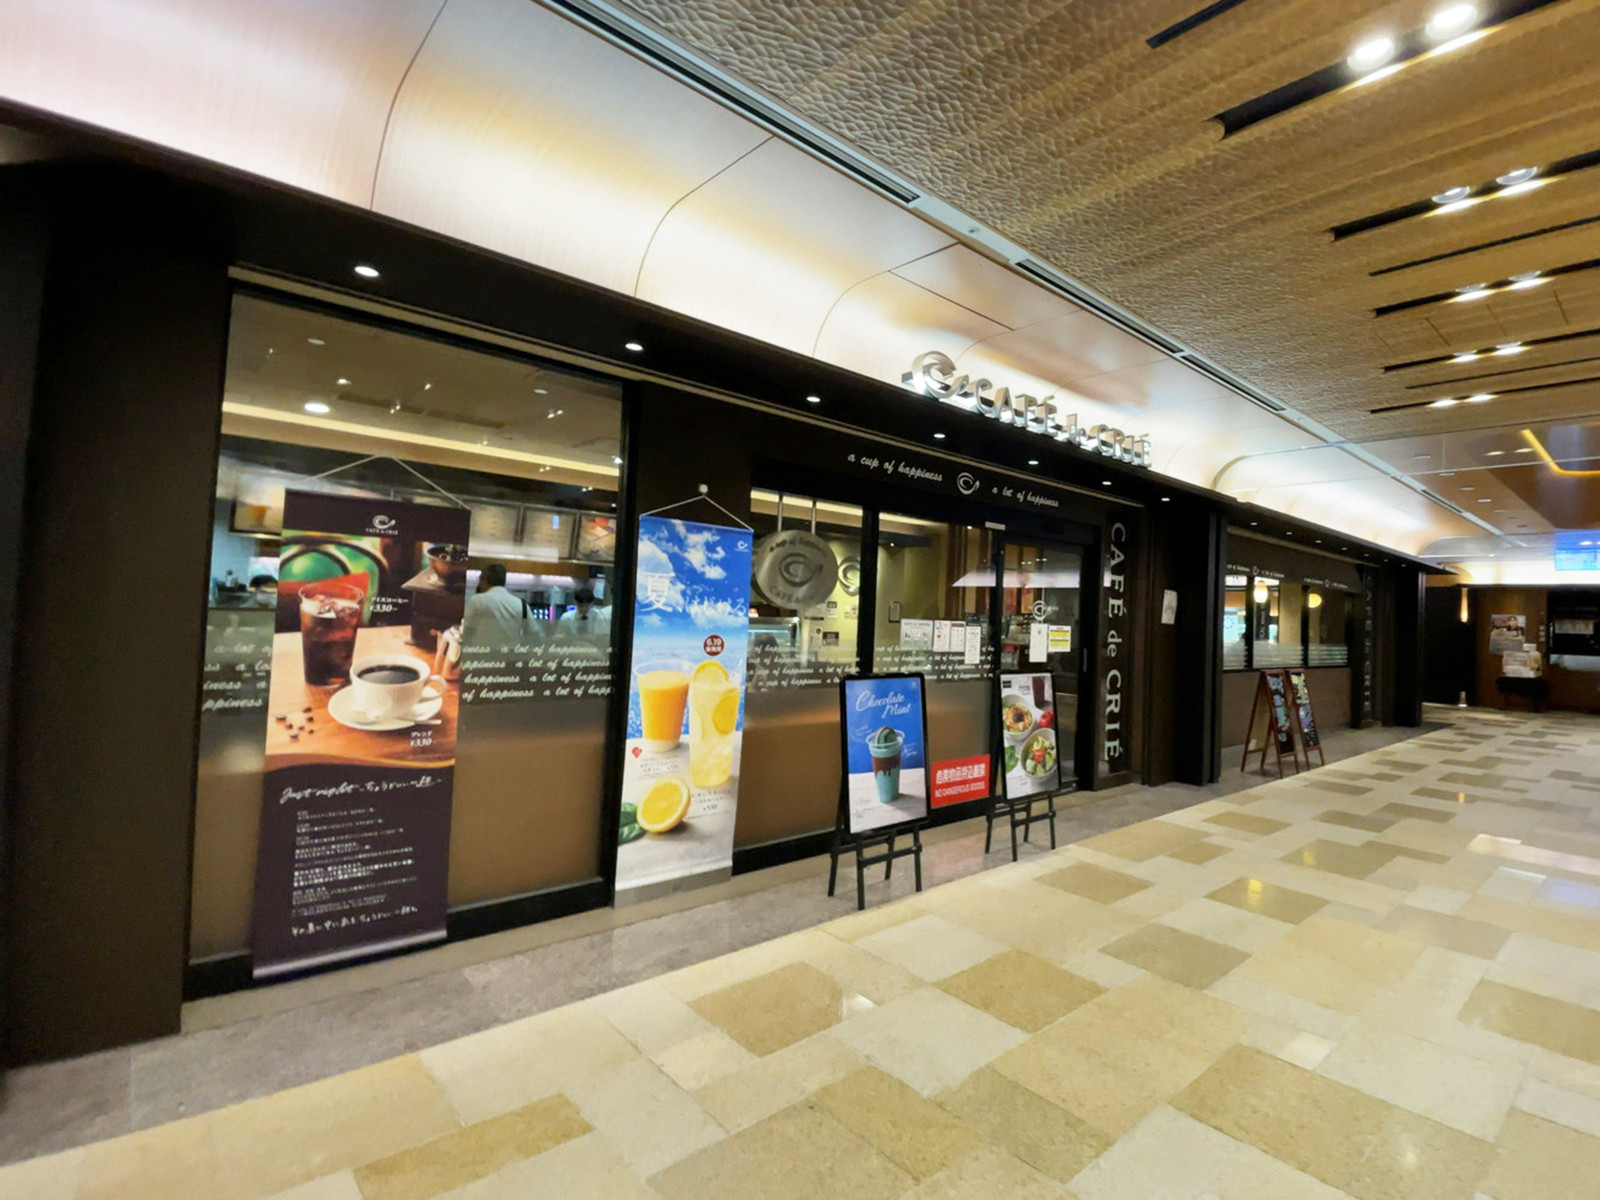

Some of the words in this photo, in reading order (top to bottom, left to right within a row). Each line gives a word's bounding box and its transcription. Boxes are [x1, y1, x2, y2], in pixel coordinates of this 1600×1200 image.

[967, 378, 1058, 437] CAFÉ
[1089, 424, 1151, 470] CRIÉ
[848, 453, 856, 462] a
[860, 456, 879, 470] cup
[883, 460, 894, 474] of
[897, 462, 943, 482] happiness
[992, 486, 998, 494] a
[1002, 486, 1013, 498] lot
[1017, 491, 1025, 503] of
[1027, 491, 1059, 508] happiness
[1108, 523, 1126, 618] CAFÉ
[514, 644, 530, 654] lot
[533, 644, 545, 656] of
[548, 644, 597, 656] happiness
[1107, 630, 1122, 657] de
[528, 659, 544, 668] lot
[547, 659, 559, 671] of
[562, 658, 610, 669] happiness
[464, 673, 520, 685] happiness
[542, 672, 557, 682] lot
[560, 672, 572, 684] of
[462, 689, 476, 702] of
[479, 687, 534, 700] happiness
[555, 686, 570, 696] lot
[573, 686, 584, 698] of
[856, 690, 905, 711] Chocolate
[881, 703, 911, 719] Mint
[1104, 669, 1123, 760] CRIÉ
[280, 787, 314, 804] Just
[316, 782, 359, 798] right
